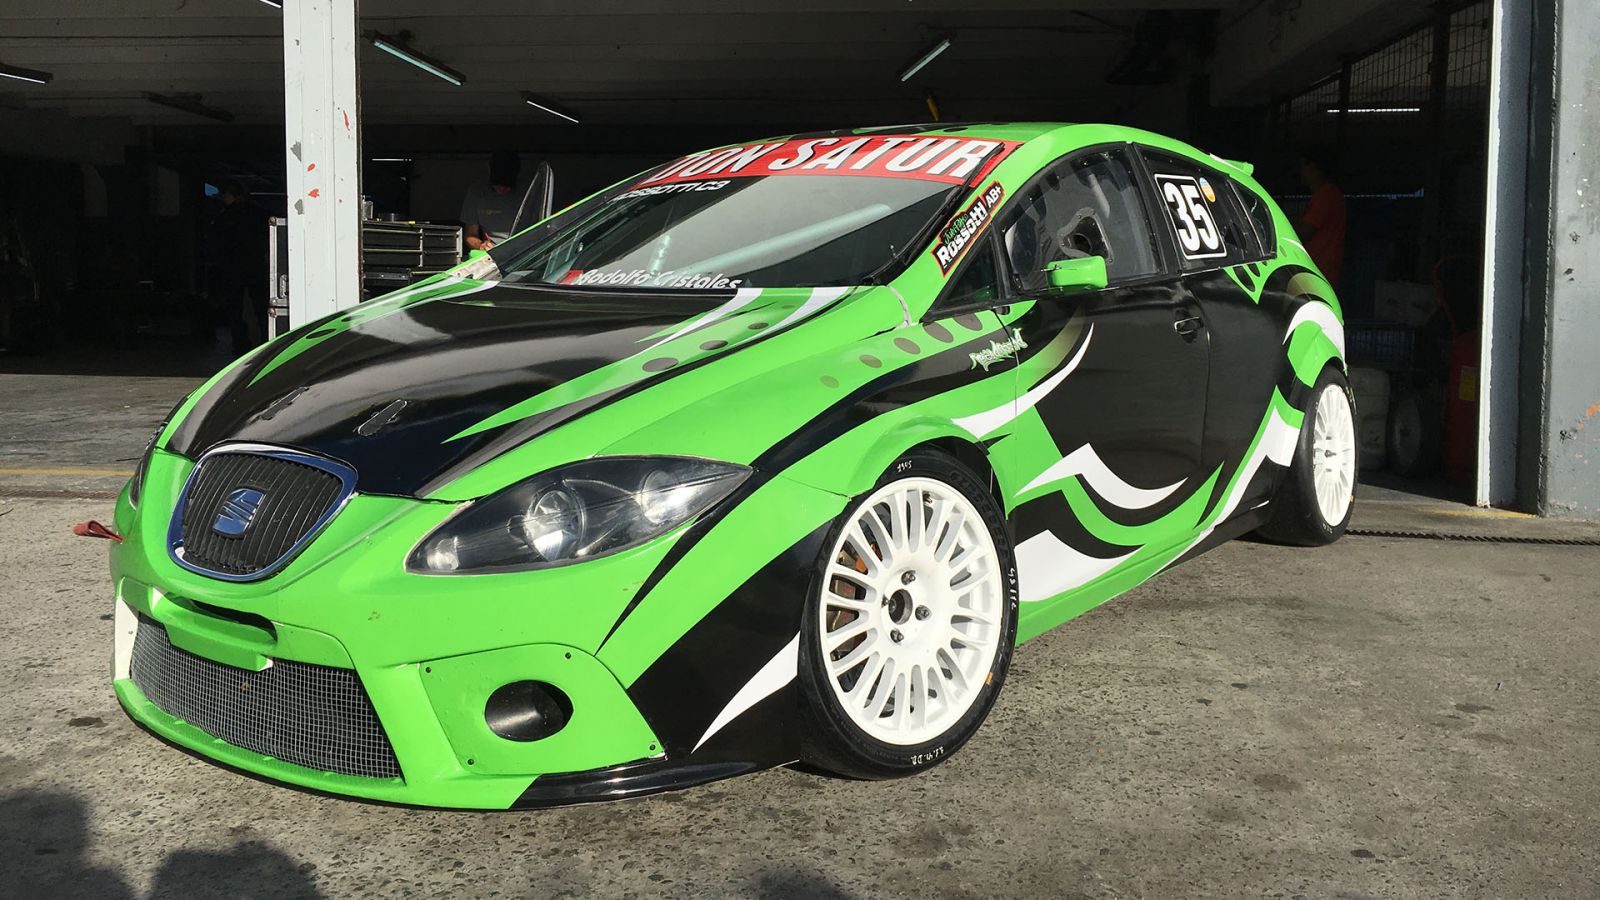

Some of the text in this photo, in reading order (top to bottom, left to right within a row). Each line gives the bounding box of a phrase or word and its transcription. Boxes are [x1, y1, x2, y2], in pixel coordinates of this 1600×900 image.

[639, 138, 1003, 185] DON SATUR
[985, 186, 1001, 208] AB+
[1164, 182, 1219, 251] 35
